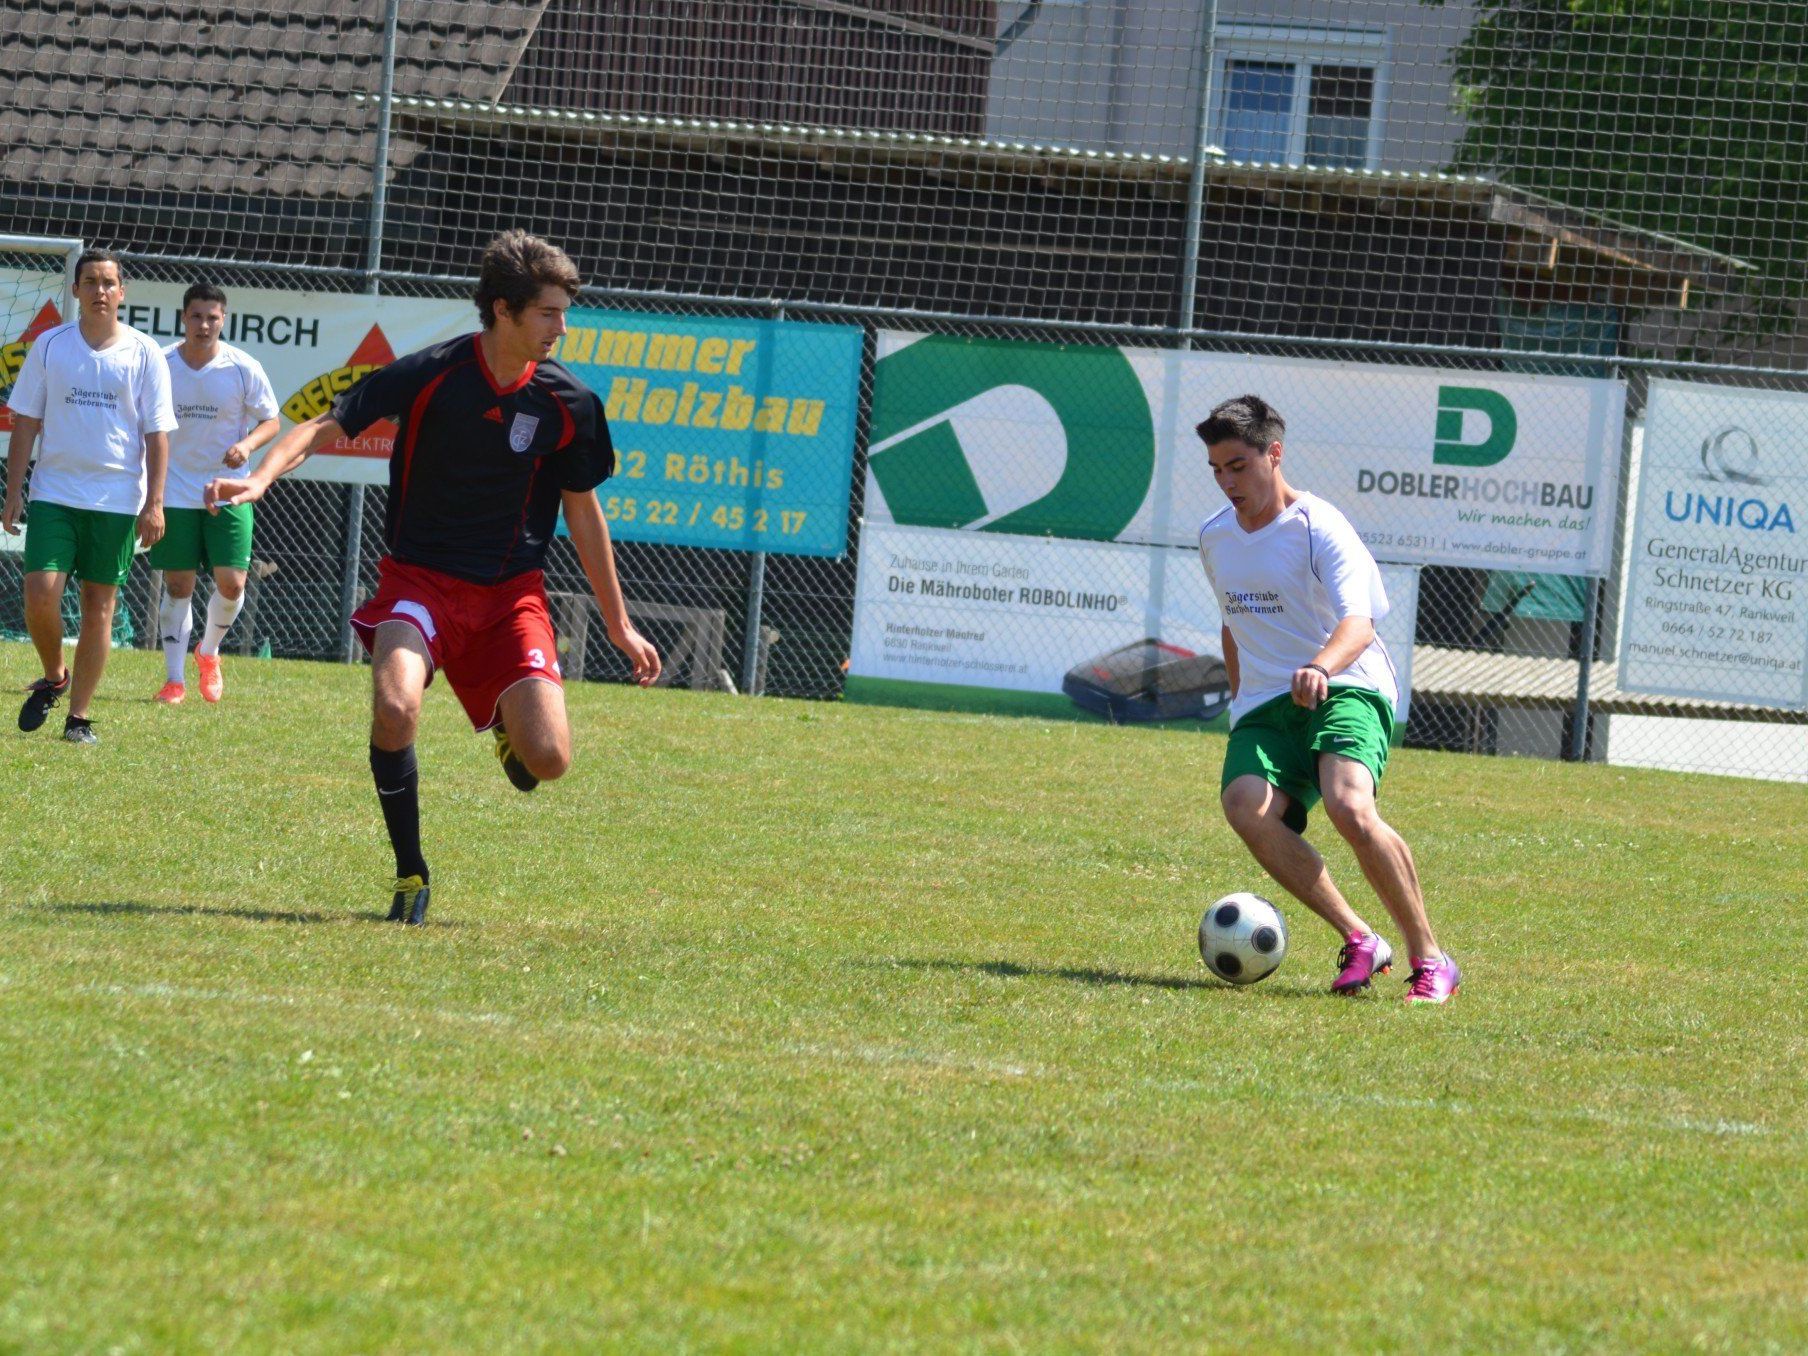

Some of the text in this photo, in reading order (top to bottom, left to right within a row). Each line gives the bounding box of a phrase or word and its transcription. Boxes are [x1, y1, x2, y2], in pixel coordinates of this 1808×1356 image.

[549, 326, 756, 375] ummer
[604, 377, 826, 436] Holzbau
[665, 453, 784, 489] Röthis
[1357, 469, 1594, 510] DOBLERHOCHBAU
[606, 496, 637, 521] 55
[646, 500, 680, 525] 22
[710, 504, 745, 529] 45
[781, 510, 807, 534] 17
[1457, 509, 1592, 531] Wir machen das!
[1664, 491, 1796, 533] UNIQA
[1451, 541, 1587, 560] www.dobler-gruppe.at
[1647, 538, 1808, 574] GeneralAgentur
[890, 554, 1030, 580] Zuhause in Ihrem Garten
[888, 575, 915, 594] Die
[920, 578, 1014, 603] Mähroboter
[1653, 567, 1793, 600] Schnetzer KG
[1645, 597, 1795, 623] Ringstraße 47, Rankweil
[886, 622, 985, 642] Hinterholzer Manfred
[910, 639, 953, 652] Rankweil
[1661, 621, 1694, 635] 0664
[1708, 626, 1724, 639] 52
[1728, 628, 1744, 641] 72
[1750, 631, 1773, 643] 187
[528, 649, 546, 669] 3
[1629, 642, 1801, 671] manuel.schnetzer@uniqa.at
